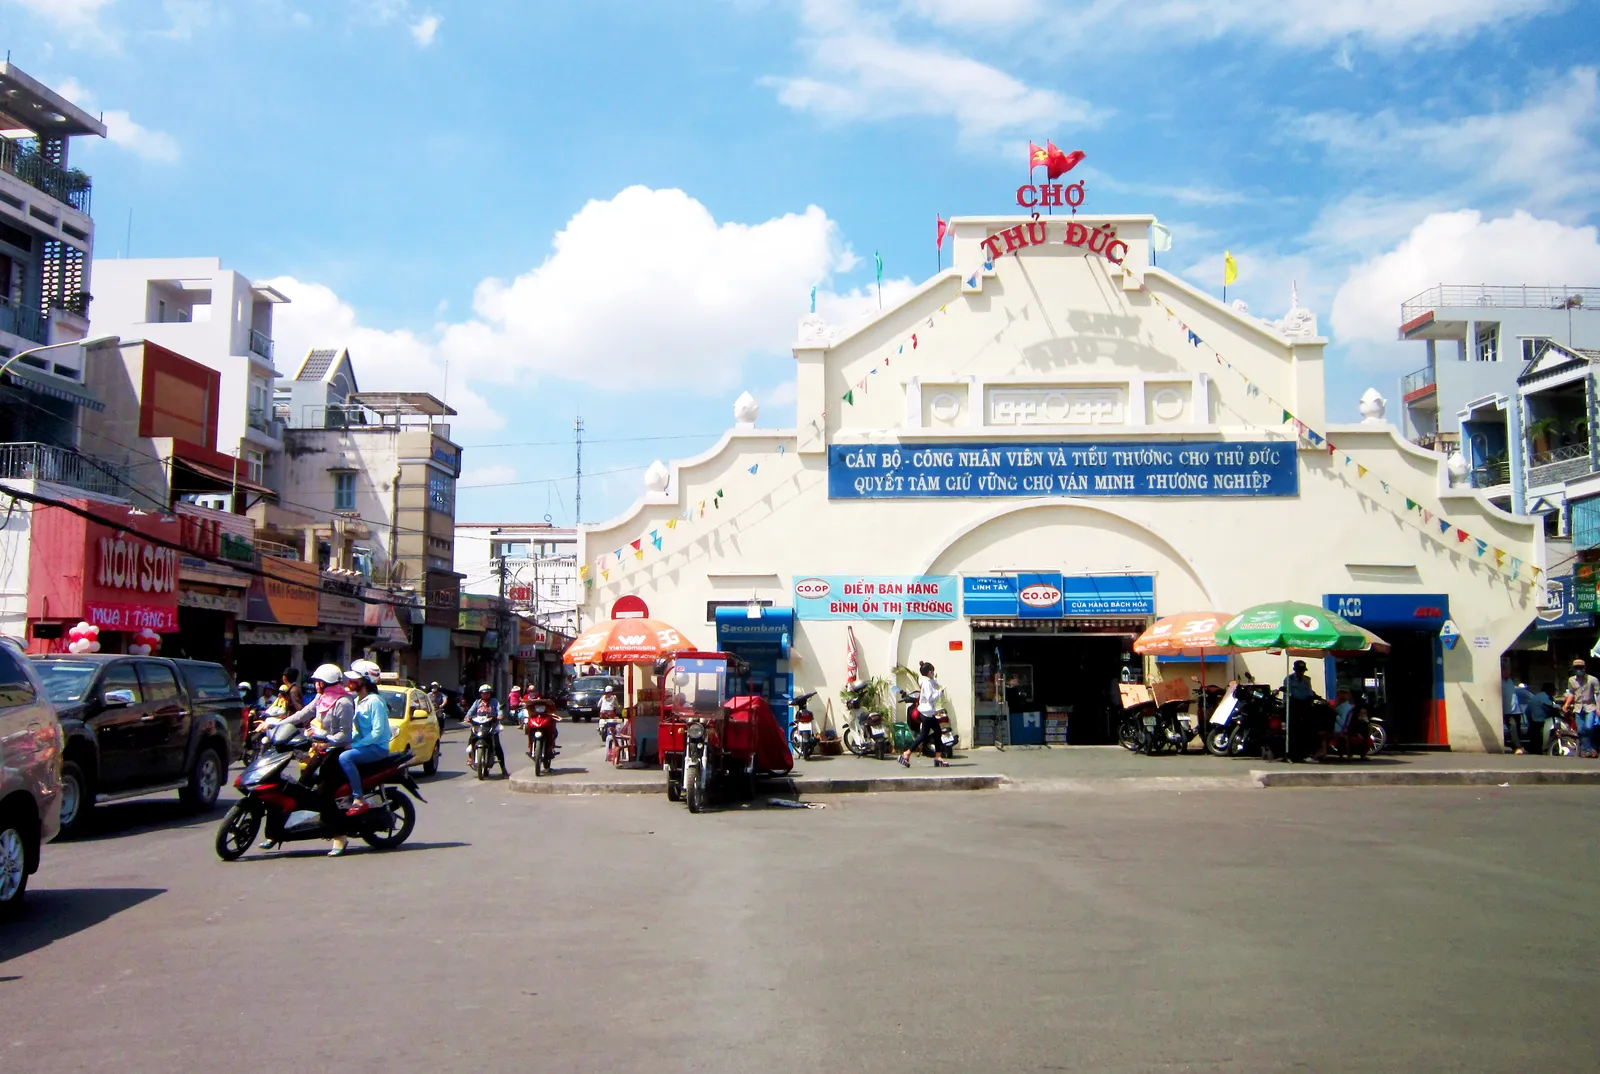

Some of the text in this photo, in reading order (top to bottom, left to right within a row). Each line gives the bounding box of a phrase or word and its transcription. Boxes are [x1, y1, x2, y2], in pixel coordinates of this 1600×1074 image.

[1016, 180, 1085, 213] CHỢ
[980, 212, 1129, 266] THỦ ĐỨC
[845, 448, 876, 468] CÁN
[882, 449, 902, 469] BỘ
[913, 448, 954, 467] CÔNG
[958, 448, 1001, 467] NHÂN
[1006, 448, 1043, 466] VIÊN
[1047, 448, 1067, 466] VÀ
[1072, 445, 1107, 467] TIỂU
[1112, 449, 1173, 466] THƯƠNG
[1213, 445, 1245, 466] THỦ
[1248, 446, 1280, 466] ĐỨC
[854, 469, 904, 494] QUYẾT
[1095, 474, 1135, 490] MINH
[1147, 472, 1208, 490] THƯƠNG
[1213, 470, 1272, 492] NGHIỆP
[99, 530, 139, 590] NÓN
[141, 544, 176, 593] SƠN
[844, 578, 939, 594] ĐIỂM BÁN HÀNG
[993, 583, 1008, 591] TÂY
[1022, 592, 1059, 600] CO.OP
[1071, 600, 1087, 608] CỬA
[1088, 600, 1109, 608] HÀNG
[1110, 600, 1130, 608] BÁCH
[830, 597, 953, 615] BÌNH ỔN THỊ TRƯỜNG
[1338, 597, 1362, 617] ACB
[1413, 607, 1442, 618] ATM
[92, 607, 120, 625] MUA
[720, 623, 789, 634] Sacombank
[656, 628, 680, 648] 3G
